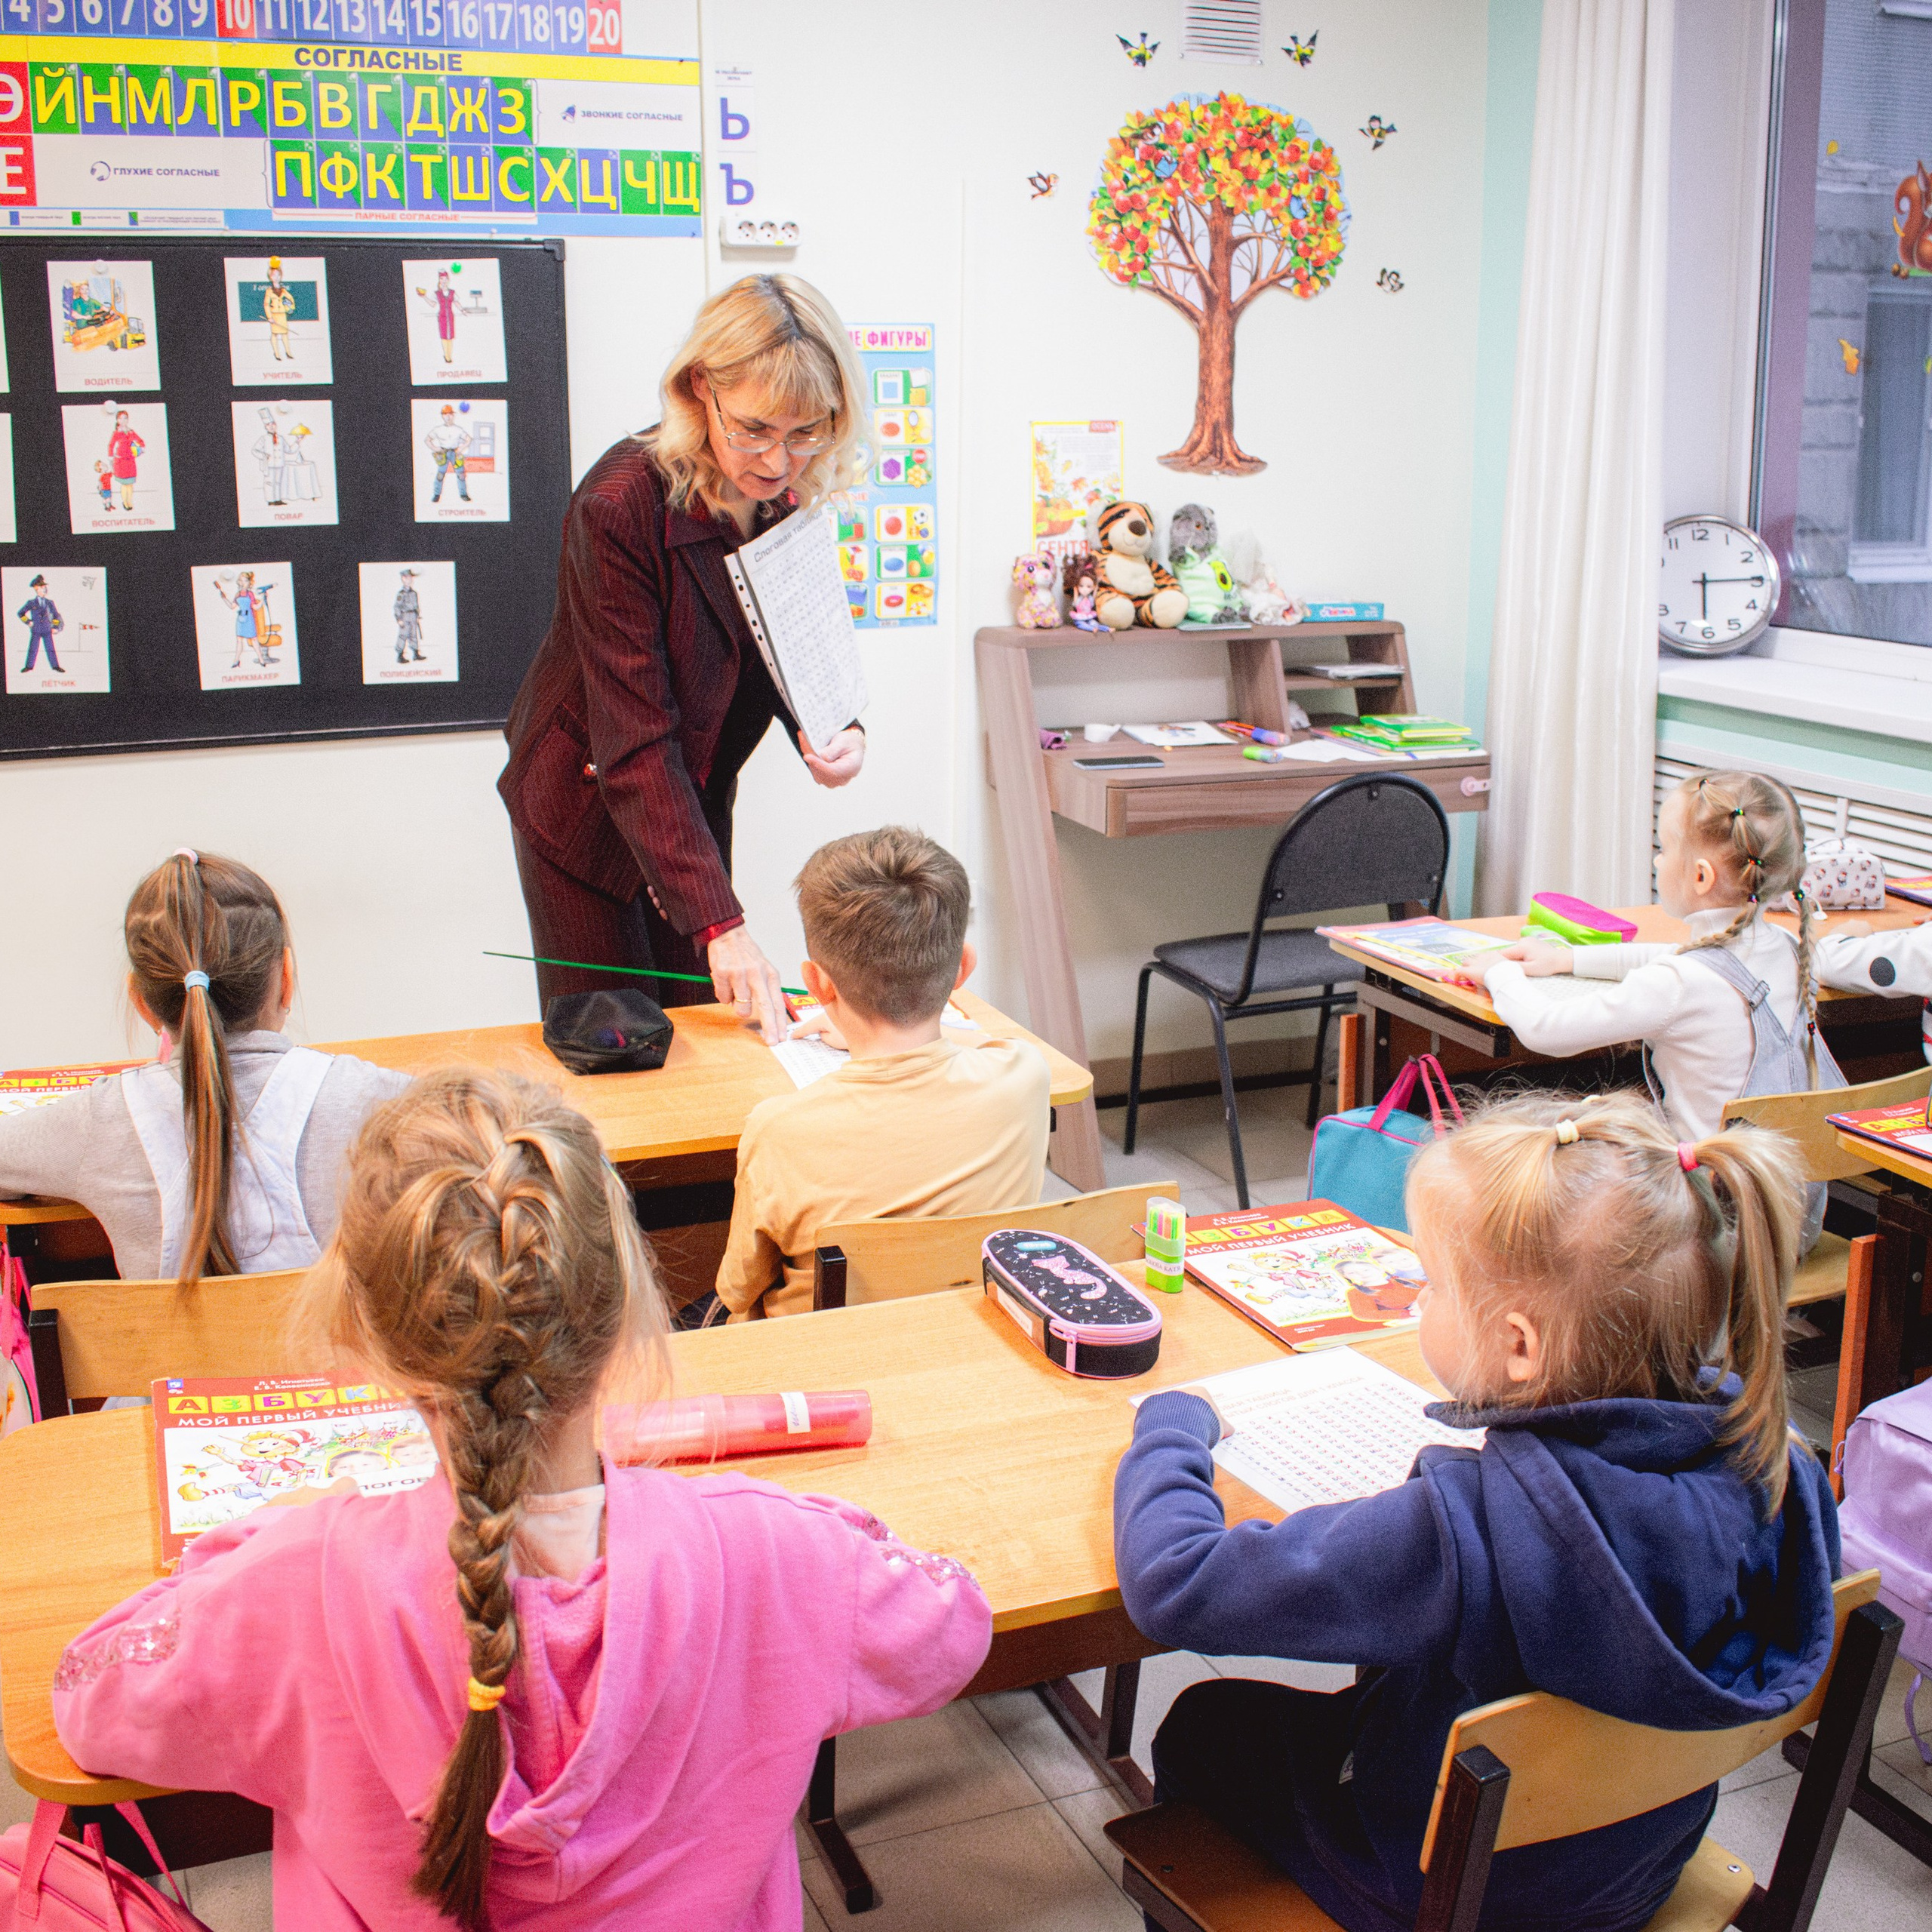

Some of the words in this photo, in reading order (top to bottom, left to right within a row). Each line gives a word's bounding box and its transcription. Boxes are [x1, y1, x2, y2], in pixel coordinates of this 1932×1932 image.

[9, 0, 31, 23] 4
[47, 0, 66, 23] 5
[82, 0, 103, 25] 6
[121, 0, 135, 25] 7
[152, 0, 174, 27] 8
[188, 0, 208, 28] 9
[226, 0, 251, 29] 10
[263, 0, 288, 30] 11
[298, 0, 330, 32] 12
[339, 0, 366, 33] 13
[374, 0, 405, 35] 14
[411, 0, 441, 36] 15
[448, 1, 478, 38] 16
[485, 2, 513, 40] 17
[518, 3, 550, 42] 18
[555, 5, 585, 43] 19
[589, 8, 621, 45] 20
[294, 48, 463, 72] СОГЛАСНЫЕ
[35, 66, 75, 125] Й
[83, 75, 122, 124] Н
[128, 76, 171, 125] М
[177, 78, 217, 125] Л
[229, 80, 260, 127] Р
[273, 81, 306, 128] Б
[320, 83, 352, 128] В
[368, 84, 392, 129] Г
[407, 86, 444, 137] Д
[449, 87, 489, 133] Ж
[498, 88, 526, 134] З
[580, 110, 623, 119] ЗВОНКИЕ
[626, 112, 683, 121] СОГЛАСНЫЕ
[113, 167, 153, 177] ГЛУХИЕ
[156, 168, 220, 177] СОГЛАСНЫЕ
[275, 151, 312, 198] П
[320, 152, 358, 198] Ф
[367, 154, 399, 199] К
[410, 155, 443, 199] Т
[451, 156, 490, 201] Ш
[498, 158, 530, 202] С
[540, 158, 574, 202] Х
[581, 159, 617, 211] Ц
[625, 161, 656, 205] Ч
[663, 162, 700, 212] Щ
[355, 212, 397, 220] ПАРНЫЕ
[399, 213, 460, 221] СОГЛАСНЫЕ
[867, 331, 927, 347] ФИГУРЫ
[436, 369, 483, 378] ПРОДАВЕЦ
[84, 377, 134, 386] ВОДИТЕЛЬ
[438, 509, 488, 517] СТРОИТЕЛЬ
[91, 517, 156, 528] ВОСПИТАТЕЛЬ
[1691, 528, 1709, 541] 12
[1724, 532, 1730, 546] 1
[753, 531, 793, 563] Слоговая
[1037, 540, 1093, 558] СЕНТЯ
[1669, 537, 1678, 550] 11
[1740, 551, 1754, 563] 2
[1746, 598, 1758, 611] 4
[1675, 621, 1687, 635] 7
[1727, 618, 1742, 631] 5
[1701, 626, 1715, 639] 6
[221, 672, 279, 683] ПАРИКМАХЕР
[380, 668, 442, 678] ПОЛИЦЕЙСКИЙ
[1185, 1213, 1343, 1244] ЗБУКА
[1186, 1243, 1227, 1256] МОЙ
[1228, 1234, 1287, 1251] ПЕРВЫЙ
[1287, 1223, 1358, 1241] УЧЕБНИК
[174, 1386, 370, 1411] АЗБУК
[178, 1416, 229, 1427] МОЙ
[237, 1410, 316, 1425] ПЕРВЫЙ
[323, 1401, 412, 1417] УЧЕБНИ
